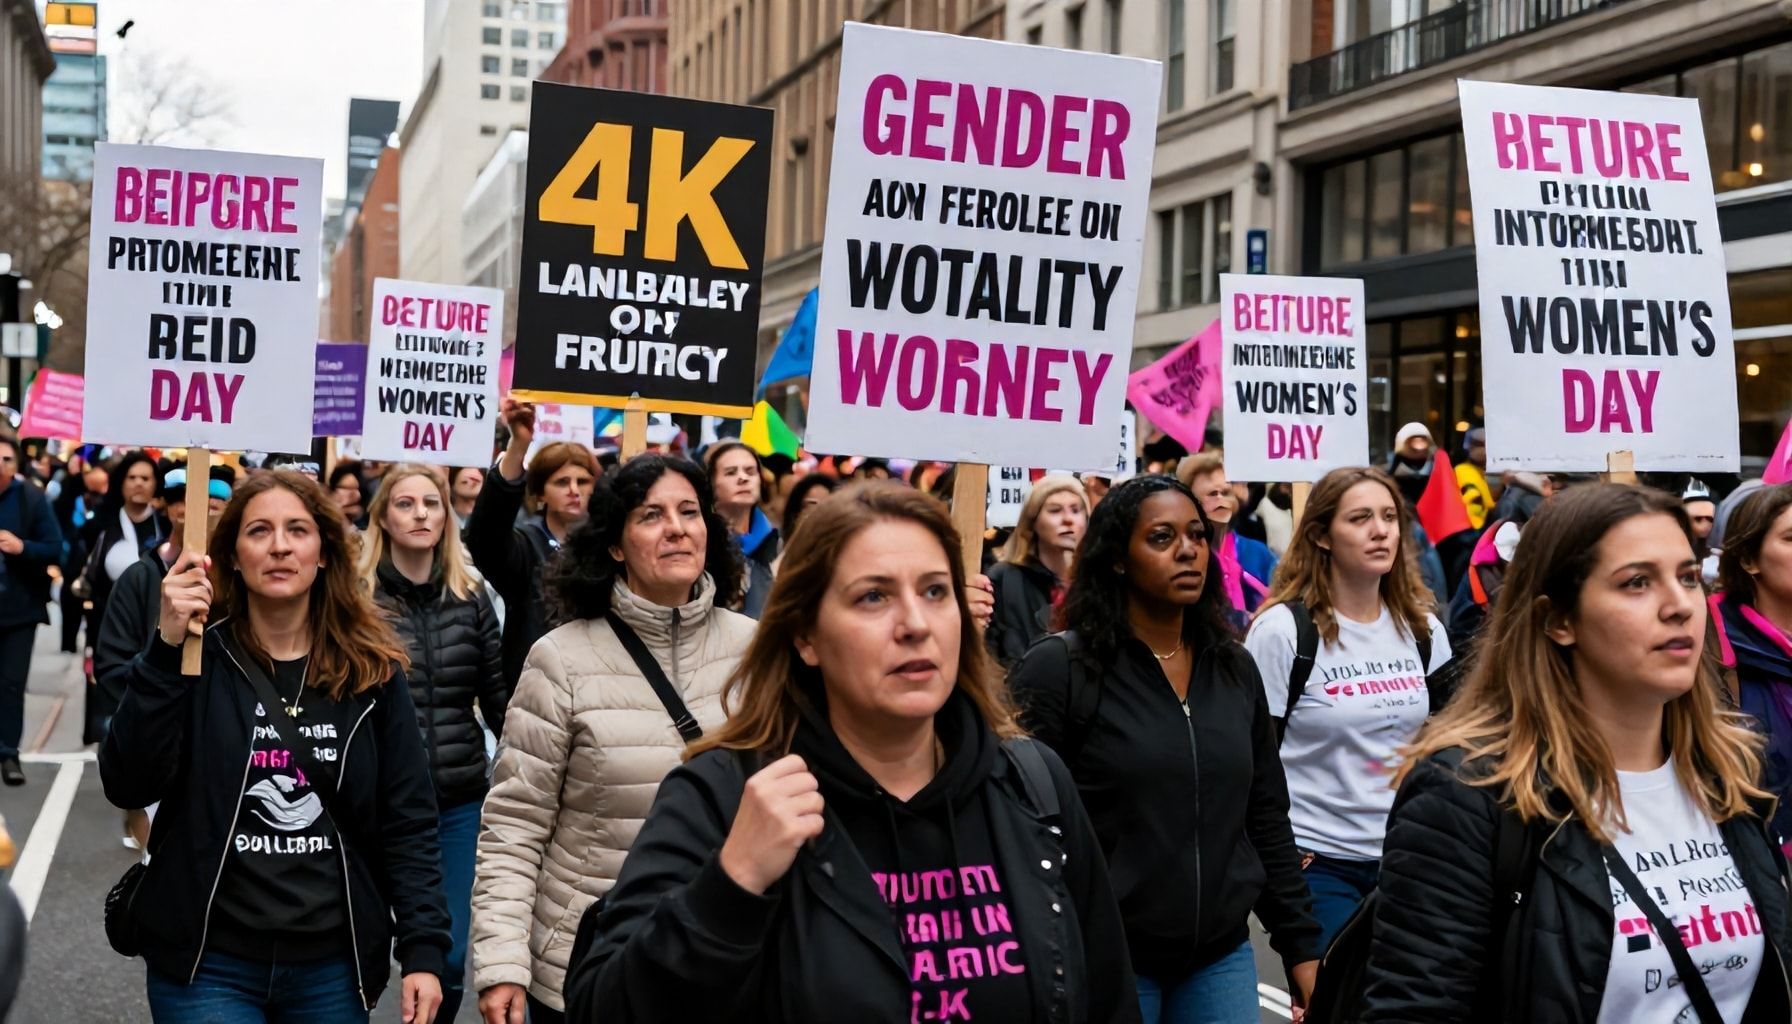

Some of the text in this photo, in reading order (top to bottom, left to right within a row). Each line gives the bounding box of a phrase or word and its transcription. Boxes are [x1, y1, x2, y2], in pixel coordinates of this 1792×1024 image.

[863, 74, 1130, 180] GENDER
[539, 122, 755, 270] 4K
[847, 239, 1123, 331] WOTALITY
[149, 314, 256, 363] REID
[1502, 296, 1715, 357] WOMEN'S
[150, 369, 245, 423] DAY
[1236, 381, 1356, 416] WOMEN'S
[1563, 369, 1660, 433] DAY
[404, 421, 454, 451] DAY
[1268, 424, 1323, 459] DAY
